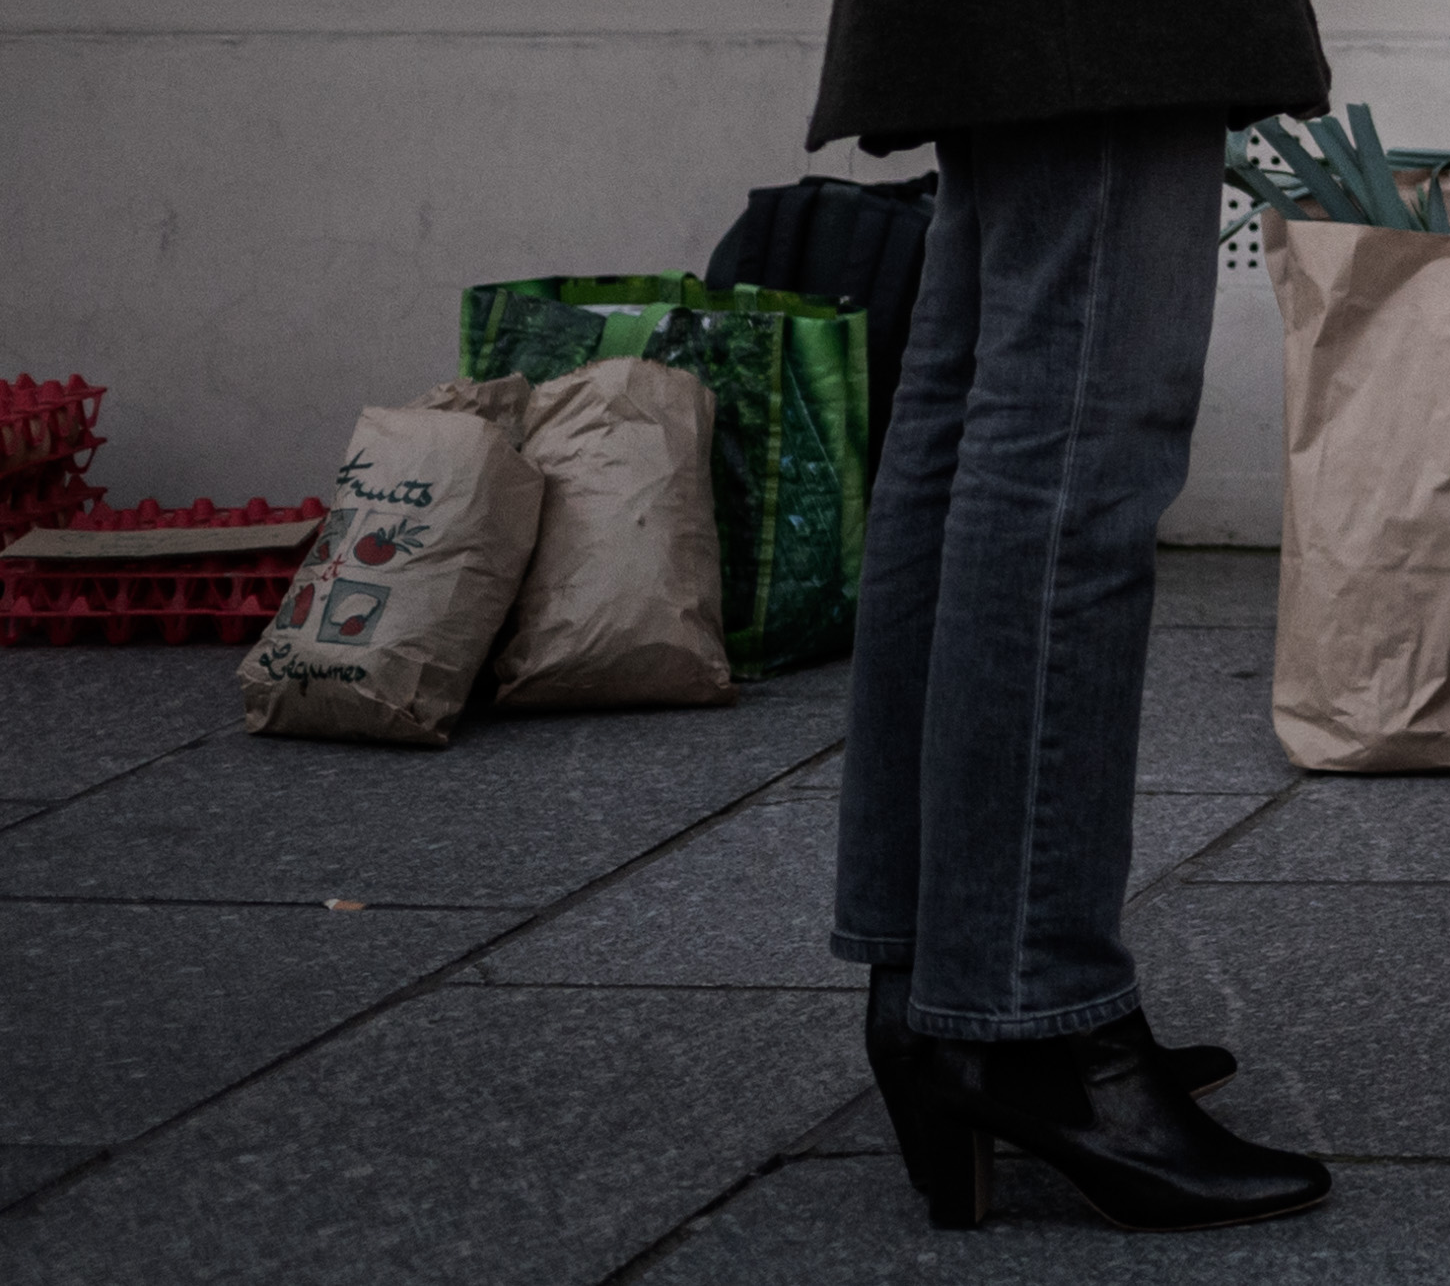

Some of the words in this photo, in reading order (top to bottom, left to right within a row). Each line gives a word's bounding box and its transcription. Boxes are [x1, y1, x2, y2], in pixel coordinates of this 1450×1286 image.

[336, 448, 433, 507] Fruits
[321, 554, 346, 581] et
[259, 643, 367, 696] Légumes
